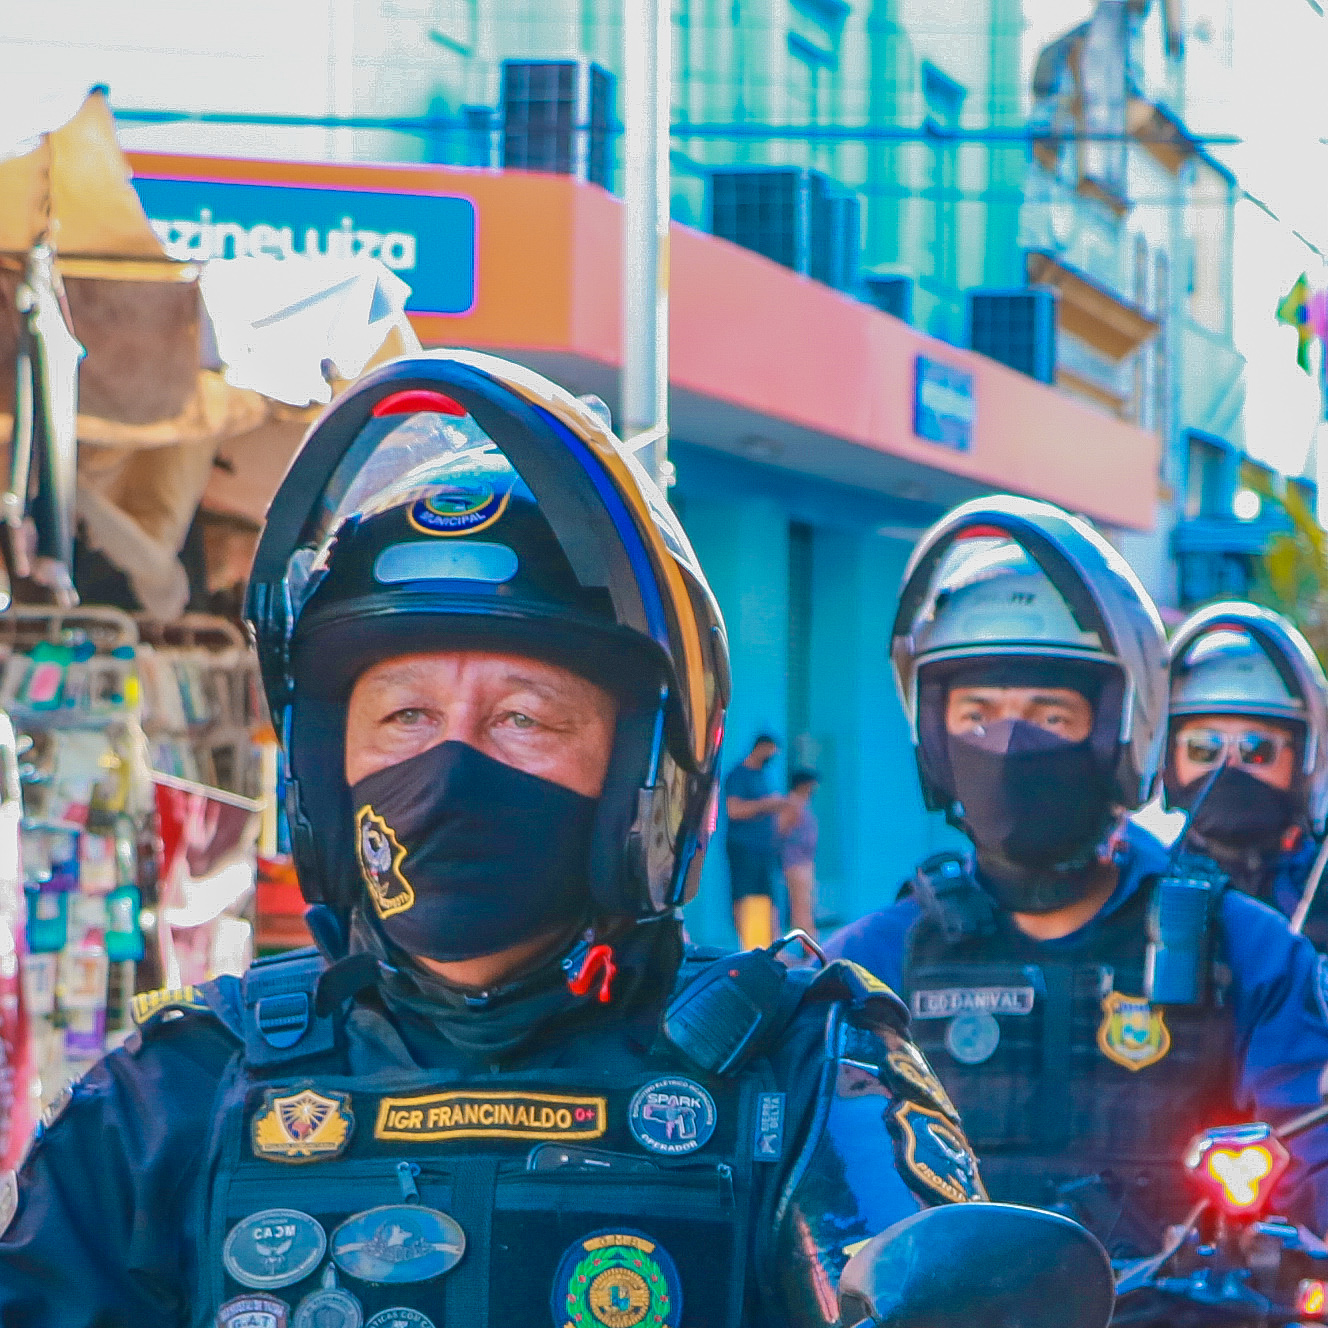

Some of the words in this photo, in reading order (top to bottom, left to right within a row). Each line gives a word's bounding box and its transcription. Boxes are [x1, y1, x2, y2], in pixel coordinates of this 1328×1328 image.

[647, 1092, 701, 1109] SPARK
[387, 1109, 423, 1130] IGR
[427, 1103, 572, 1129] FRANCINALDO
[641, 1133, 698, 1152] OPERADOR
